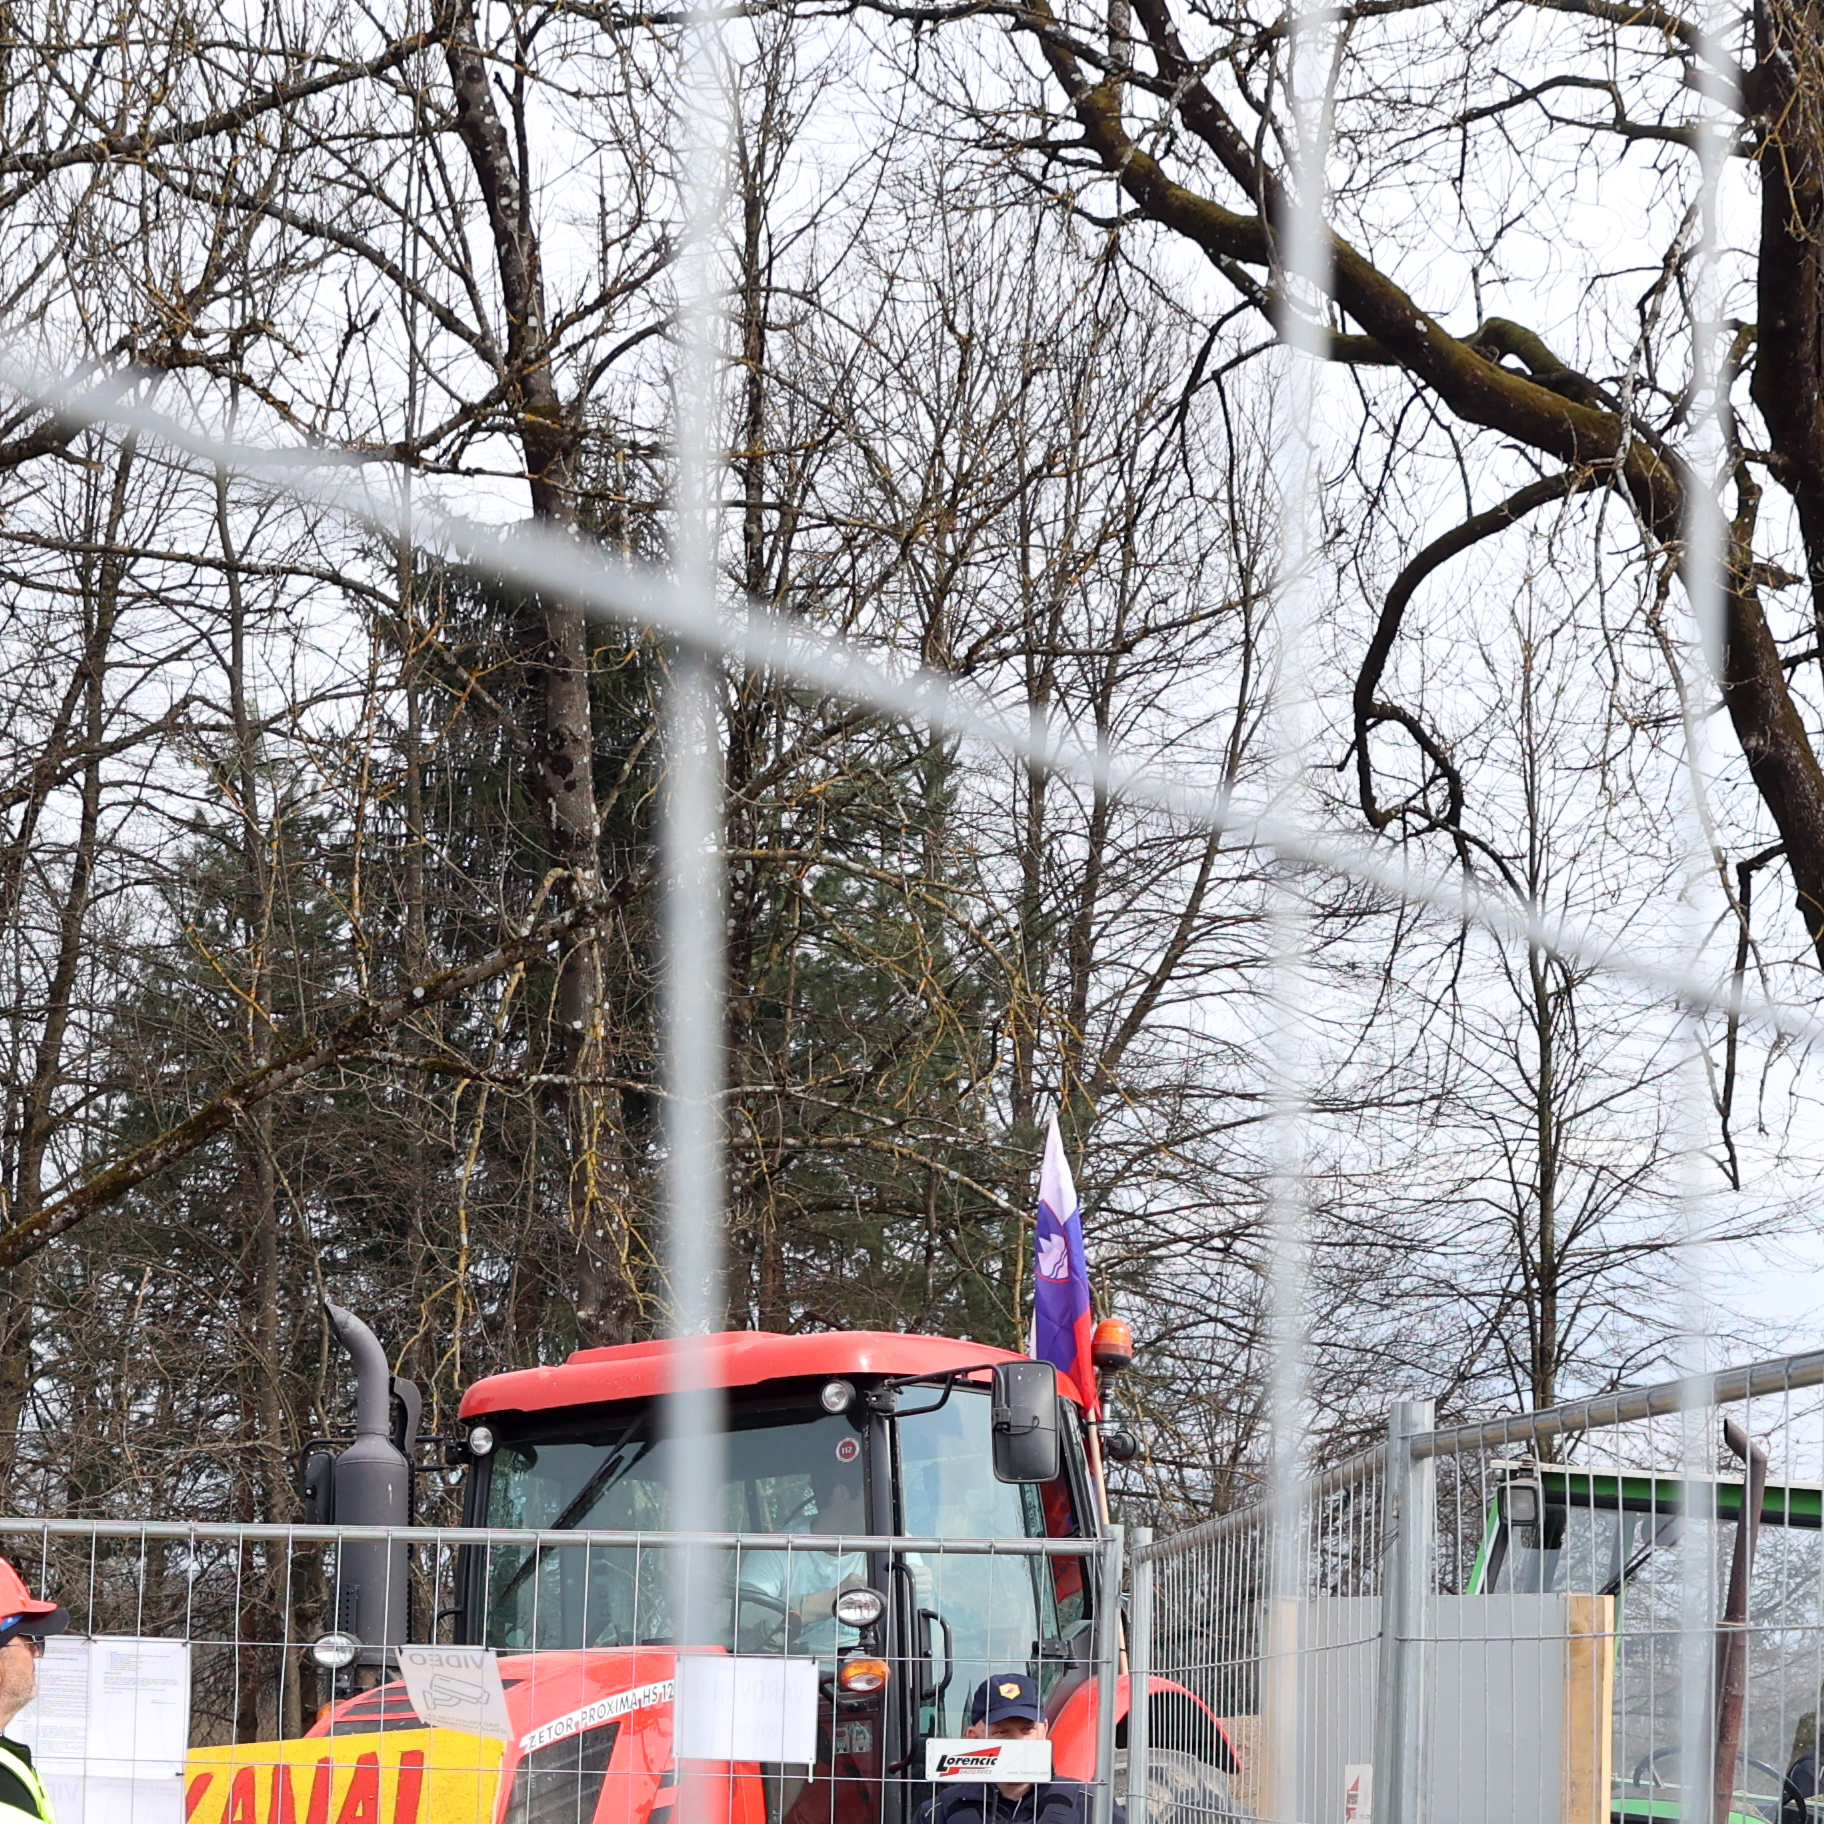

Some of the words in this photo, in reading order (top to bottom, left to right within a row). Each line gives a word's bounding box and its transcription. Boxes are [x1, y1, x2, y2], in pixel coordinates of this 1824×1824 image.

[527, 1716, 575, 1750] ZETOR
[580, 1692, 640, 1728] PROXIMA
[642, 1686, 658, 1707] HS
[935, 1753, 998, 1772] Lorencic
